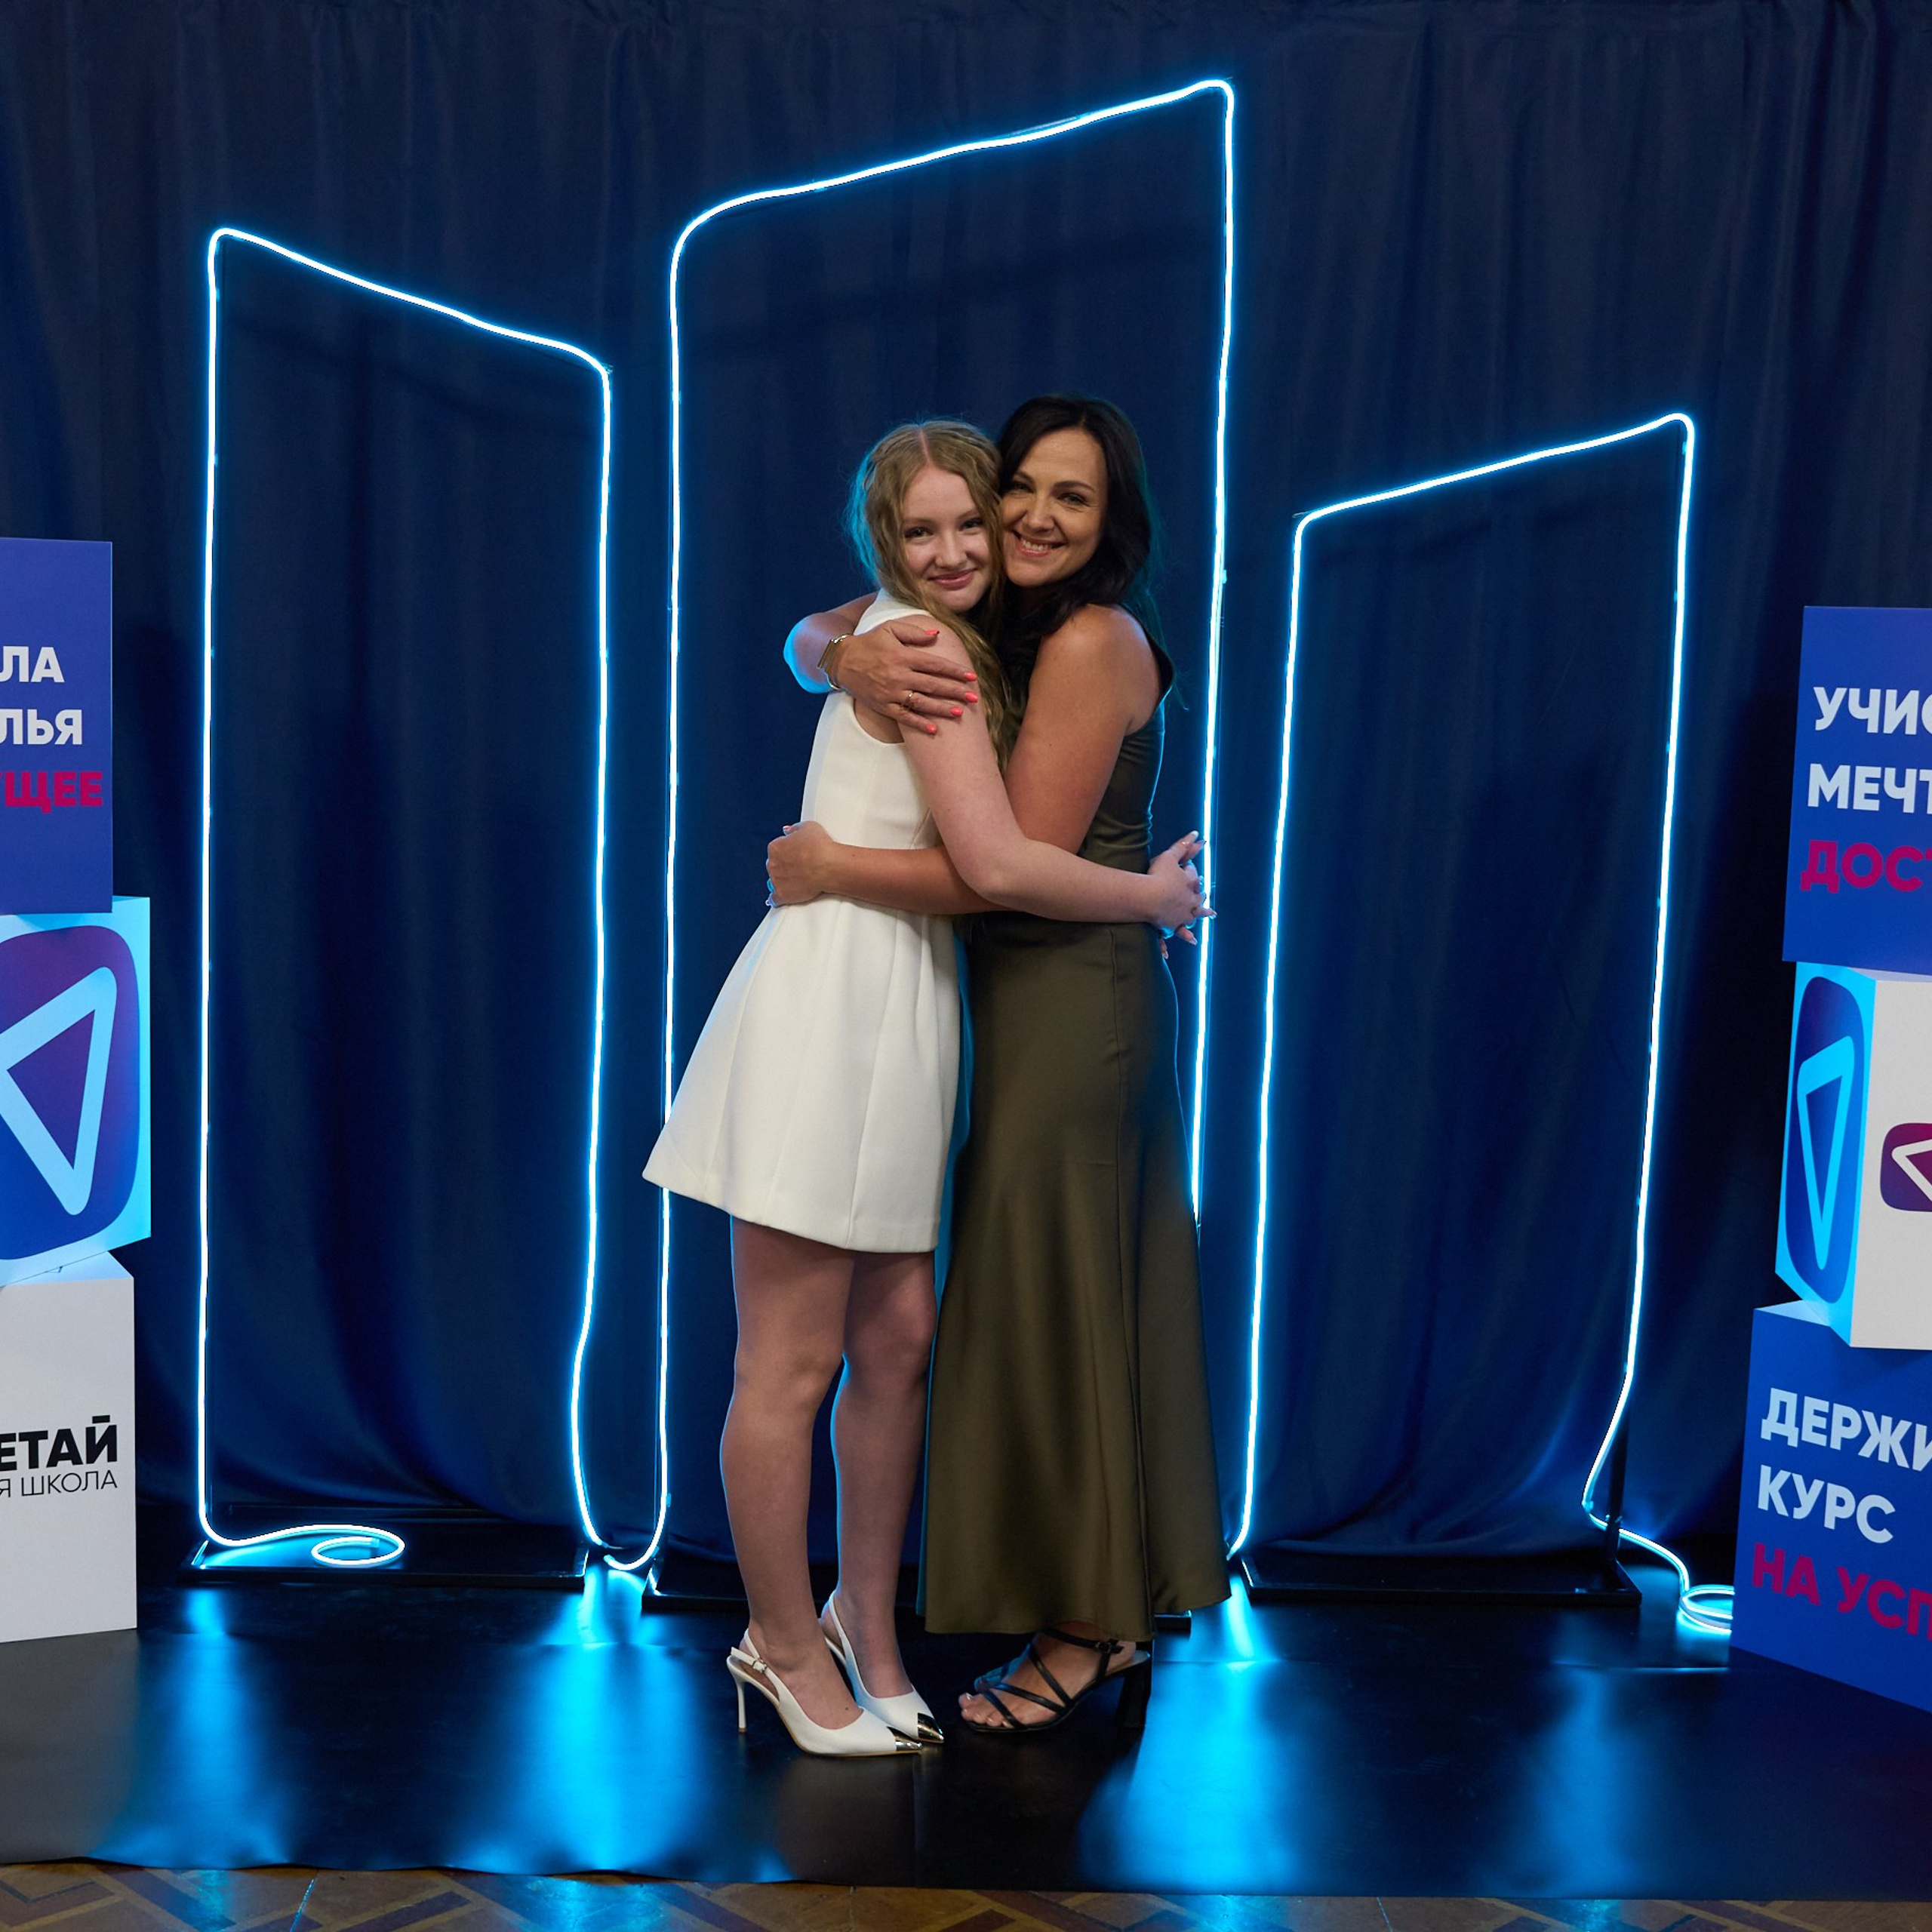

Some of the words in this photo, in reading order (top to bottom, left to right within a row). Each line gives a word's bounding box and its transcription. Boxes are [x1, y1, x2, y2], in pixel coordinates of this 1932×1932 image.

[1814, 687, 1932, 735] УЧИ
[0, 771, 103, 814] ЩЕЕ
[1801, 840, 1932, 893] ДОС
[21, 1469, 118, 1497] ШКОЛА
[1758, 1465, 1896, 1543] КУРС
[1752, 1543, 1821, 1606] НА
[1837, 1566, 1932, 1641] УСП
